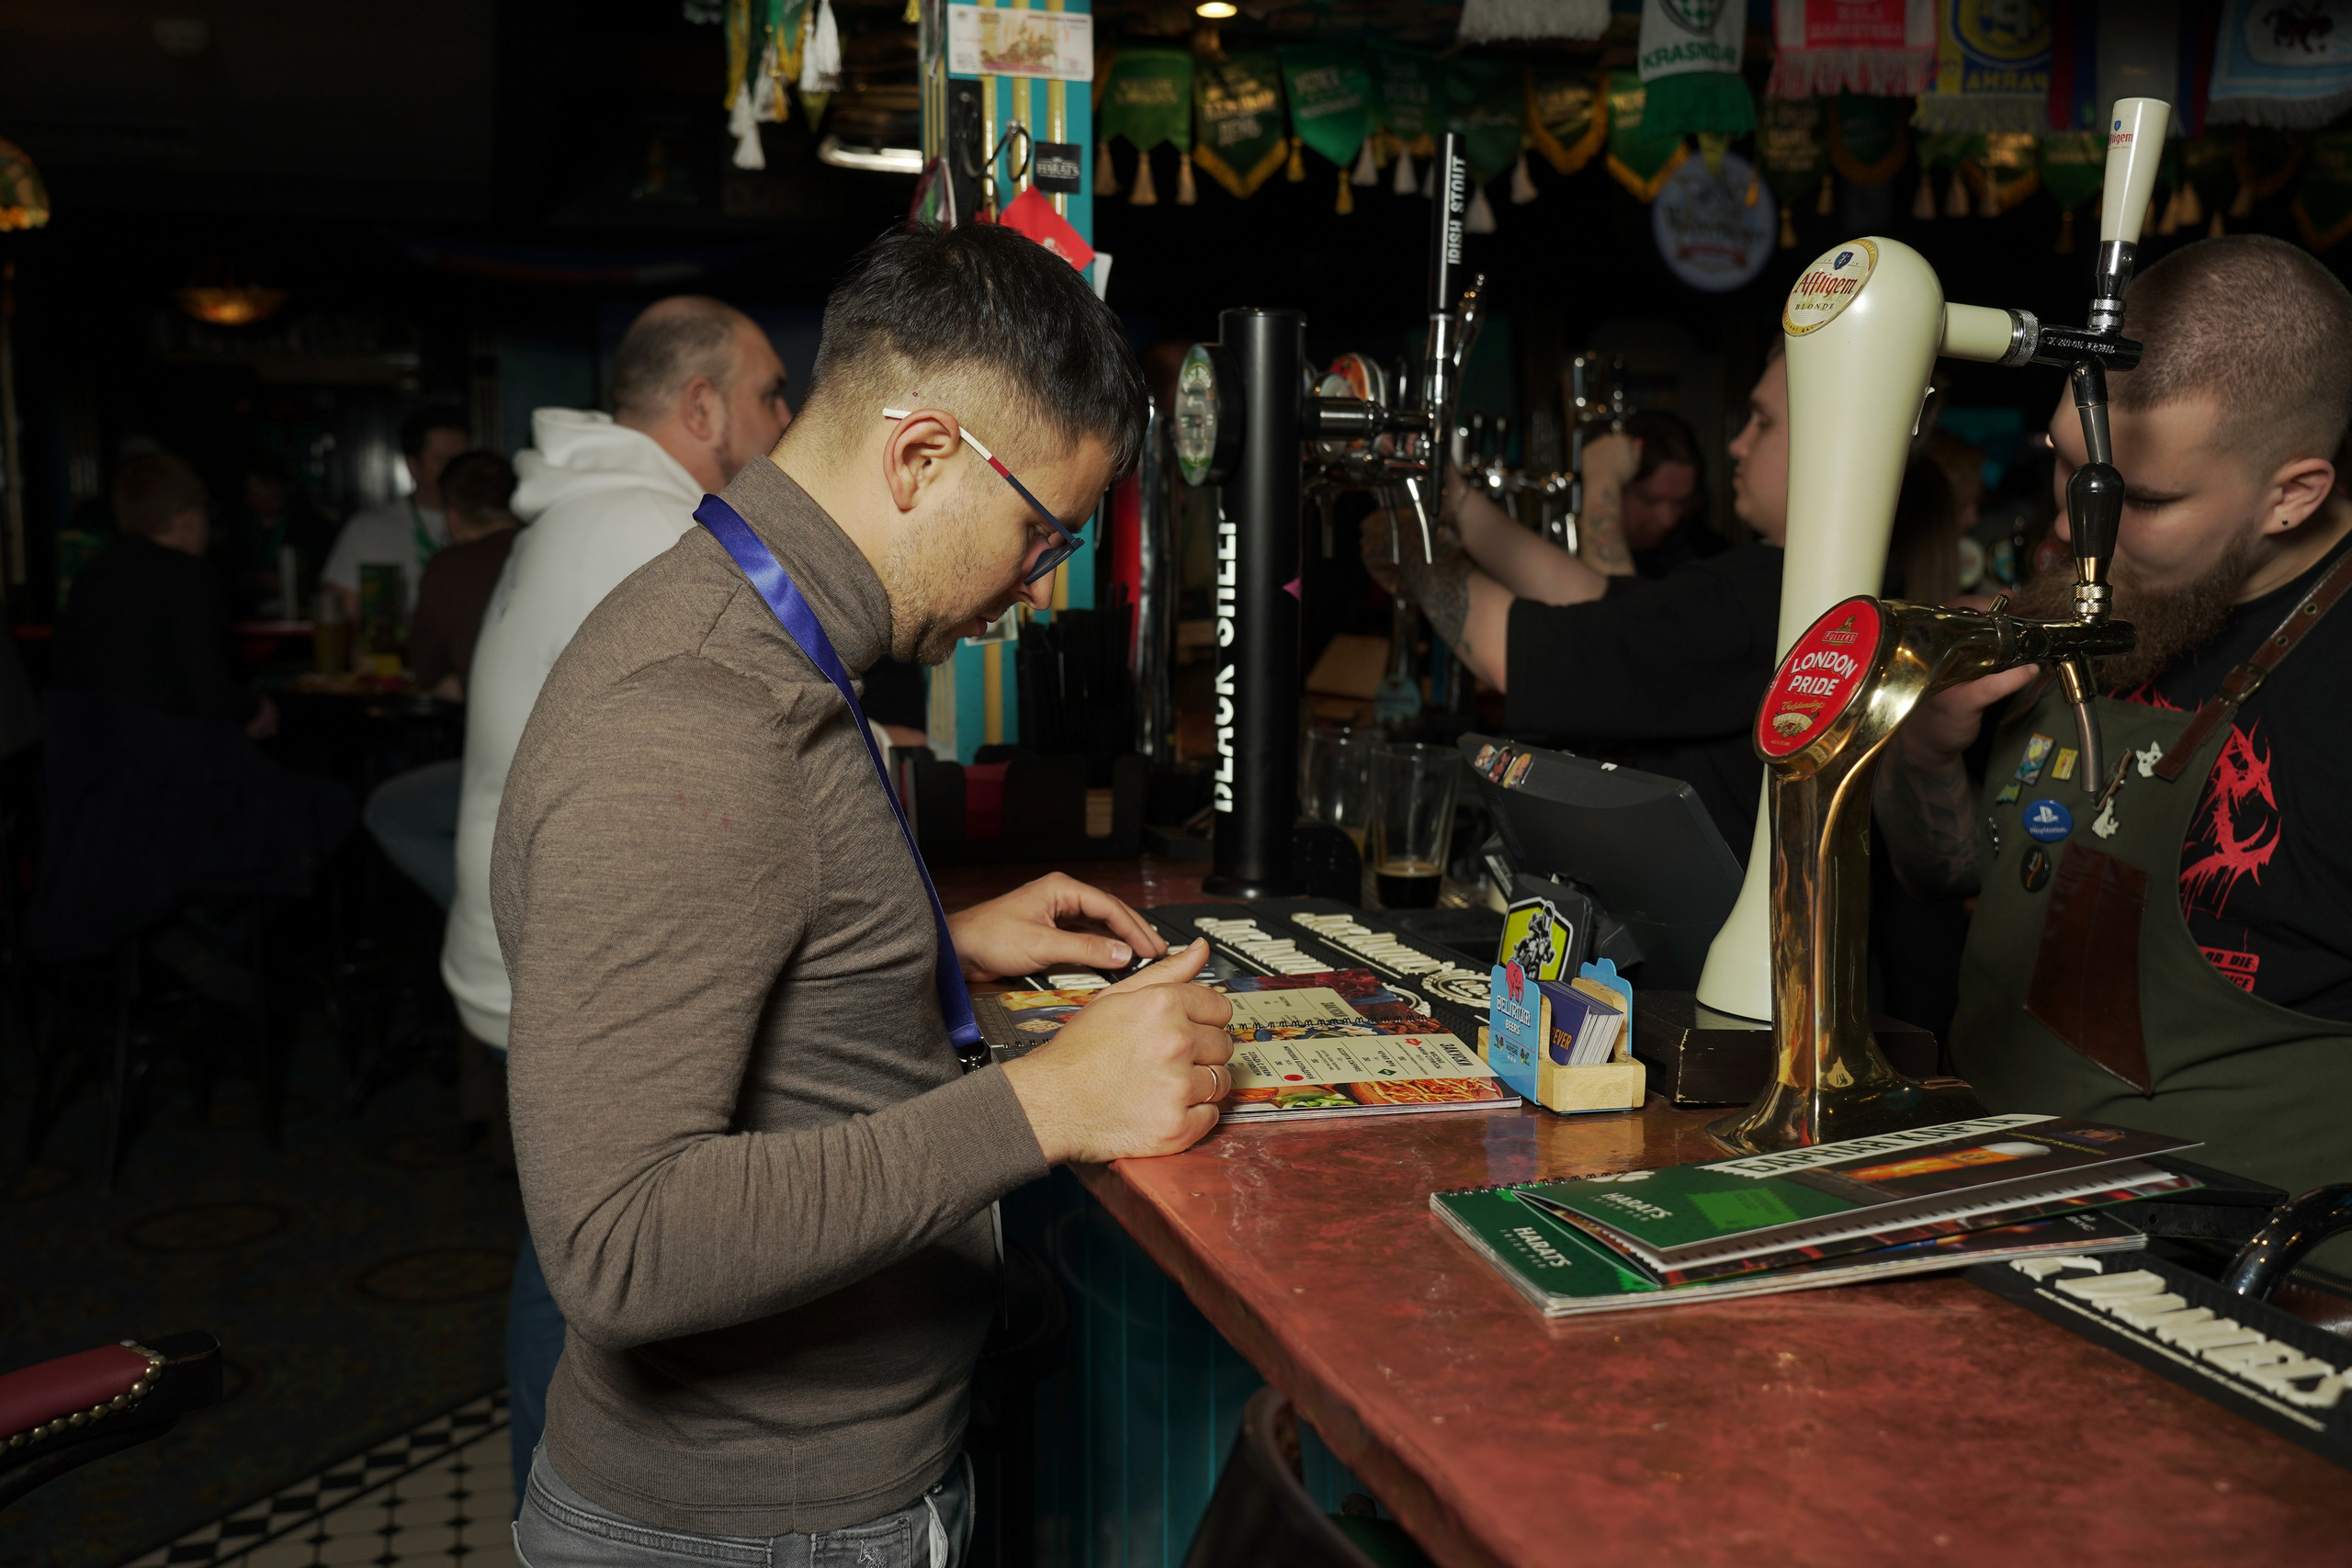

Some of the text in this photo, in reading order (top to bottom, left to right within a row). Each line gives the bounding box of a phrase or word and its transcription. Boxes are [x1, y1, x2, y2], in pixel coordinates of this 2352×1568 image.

[1447, 154, 1467, 265] IRISH STOUT
[1792, 272, 1858, 299] Affligem
[1792, 650, 1859, 680] LONDON
[1788, 675, 1840, 697] PRIDE
[2029, 826, 2066, 835] PlayStation
[2229, 955, 2254, 969] DIE
[1505, 1019, 1521, 1036] BEERS
[1440, 1043, 1474, 1066] ЗАКУСКИ
[1726, 1139, 1879, 1173] БАРНАЯ
[1880, 1118, 2026, 1148] КАРТА
[1600, 1191, 1674, 1220] HARATS
[1513, 1226, 1574, 1269] HARATS
